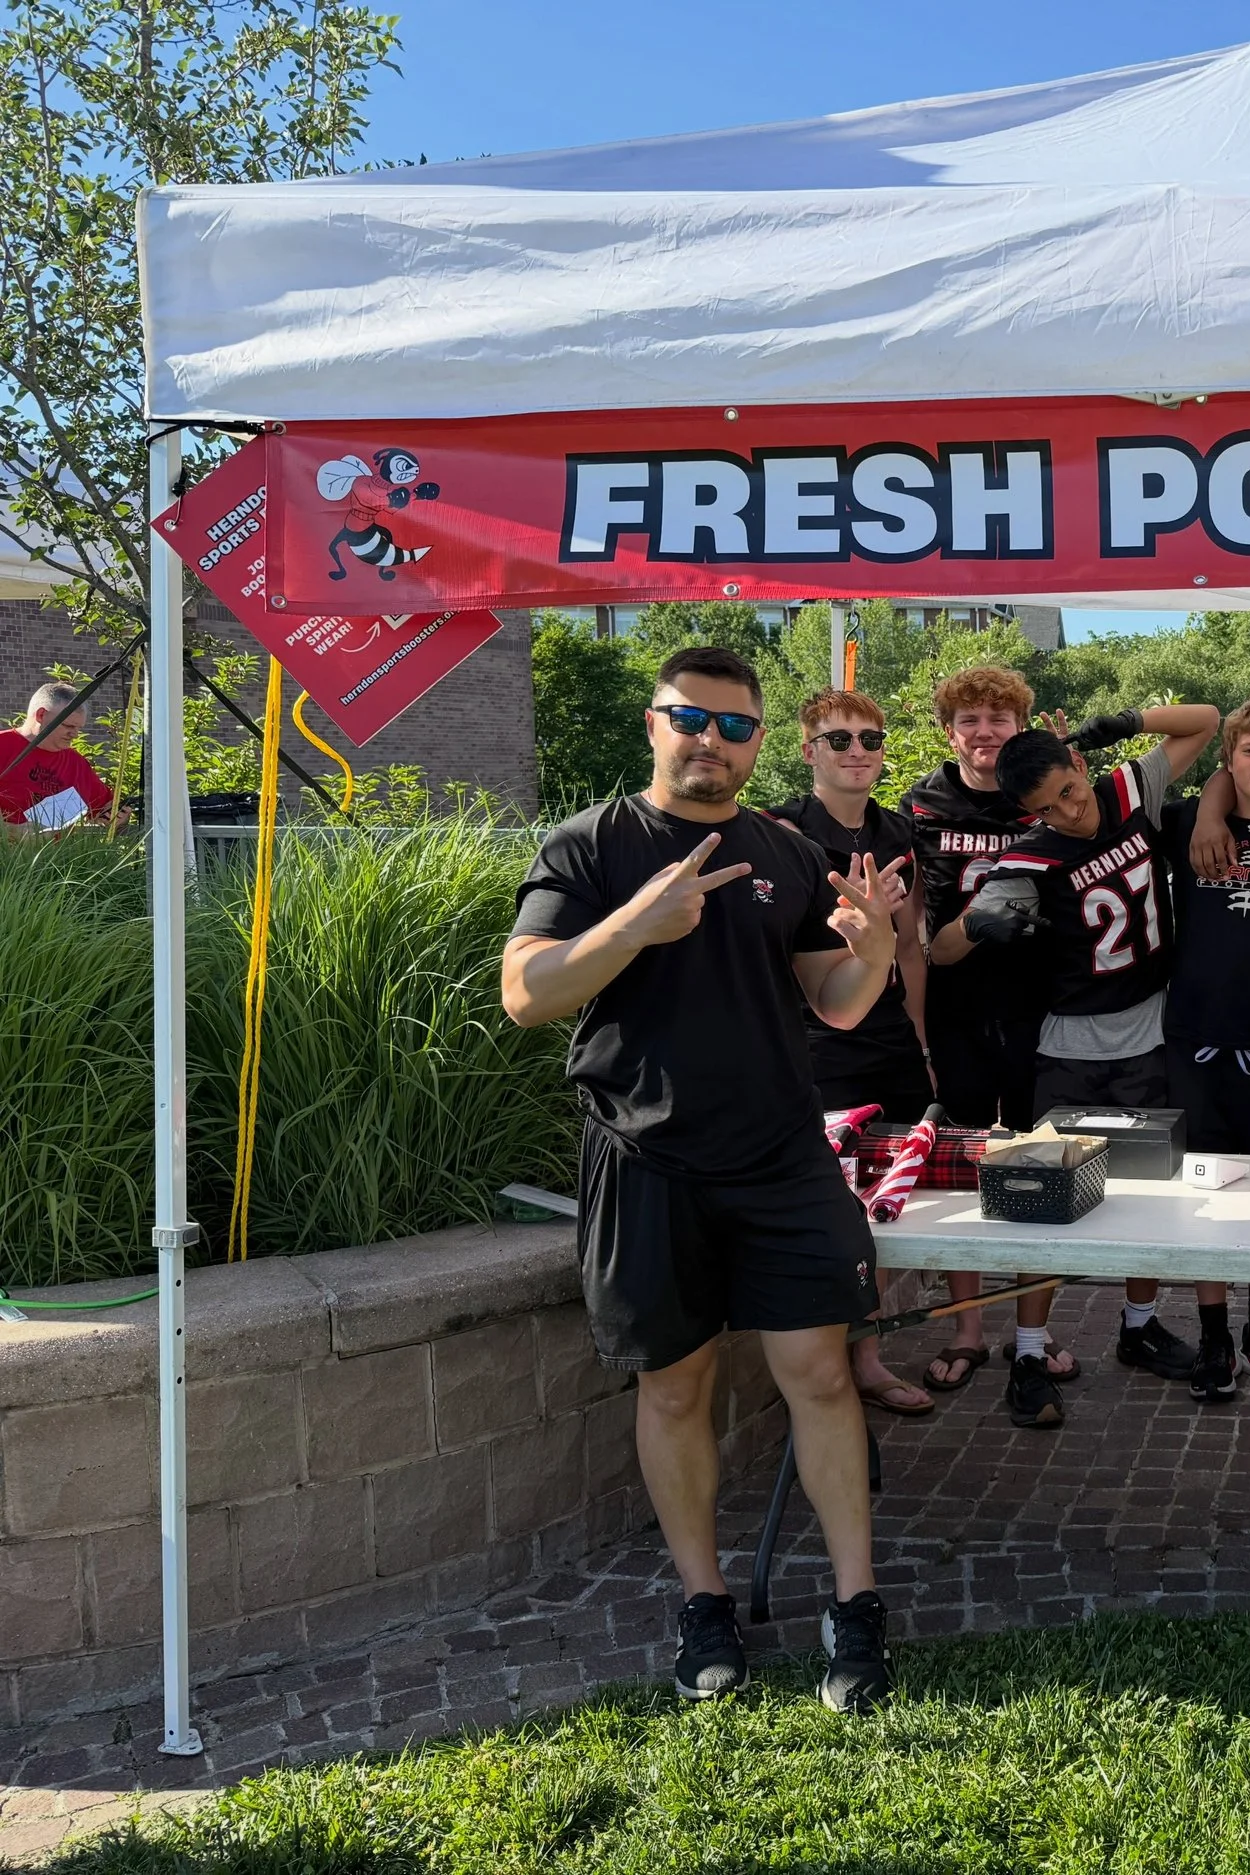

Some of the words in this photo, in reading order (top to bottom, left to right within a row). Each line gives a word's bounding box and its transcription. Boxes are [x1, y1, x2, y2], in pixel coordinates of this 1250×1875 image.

[205, 485, 267, 542] HERNDO
[559, 440, 1054, 563] FRESH
[198, 518, 261, 571] SPORTS
[313, 621, 353, 656] WEAR!
[1069, 832, 1150, 892] HERNDON
[1081, 858, 1161, 974] 27
